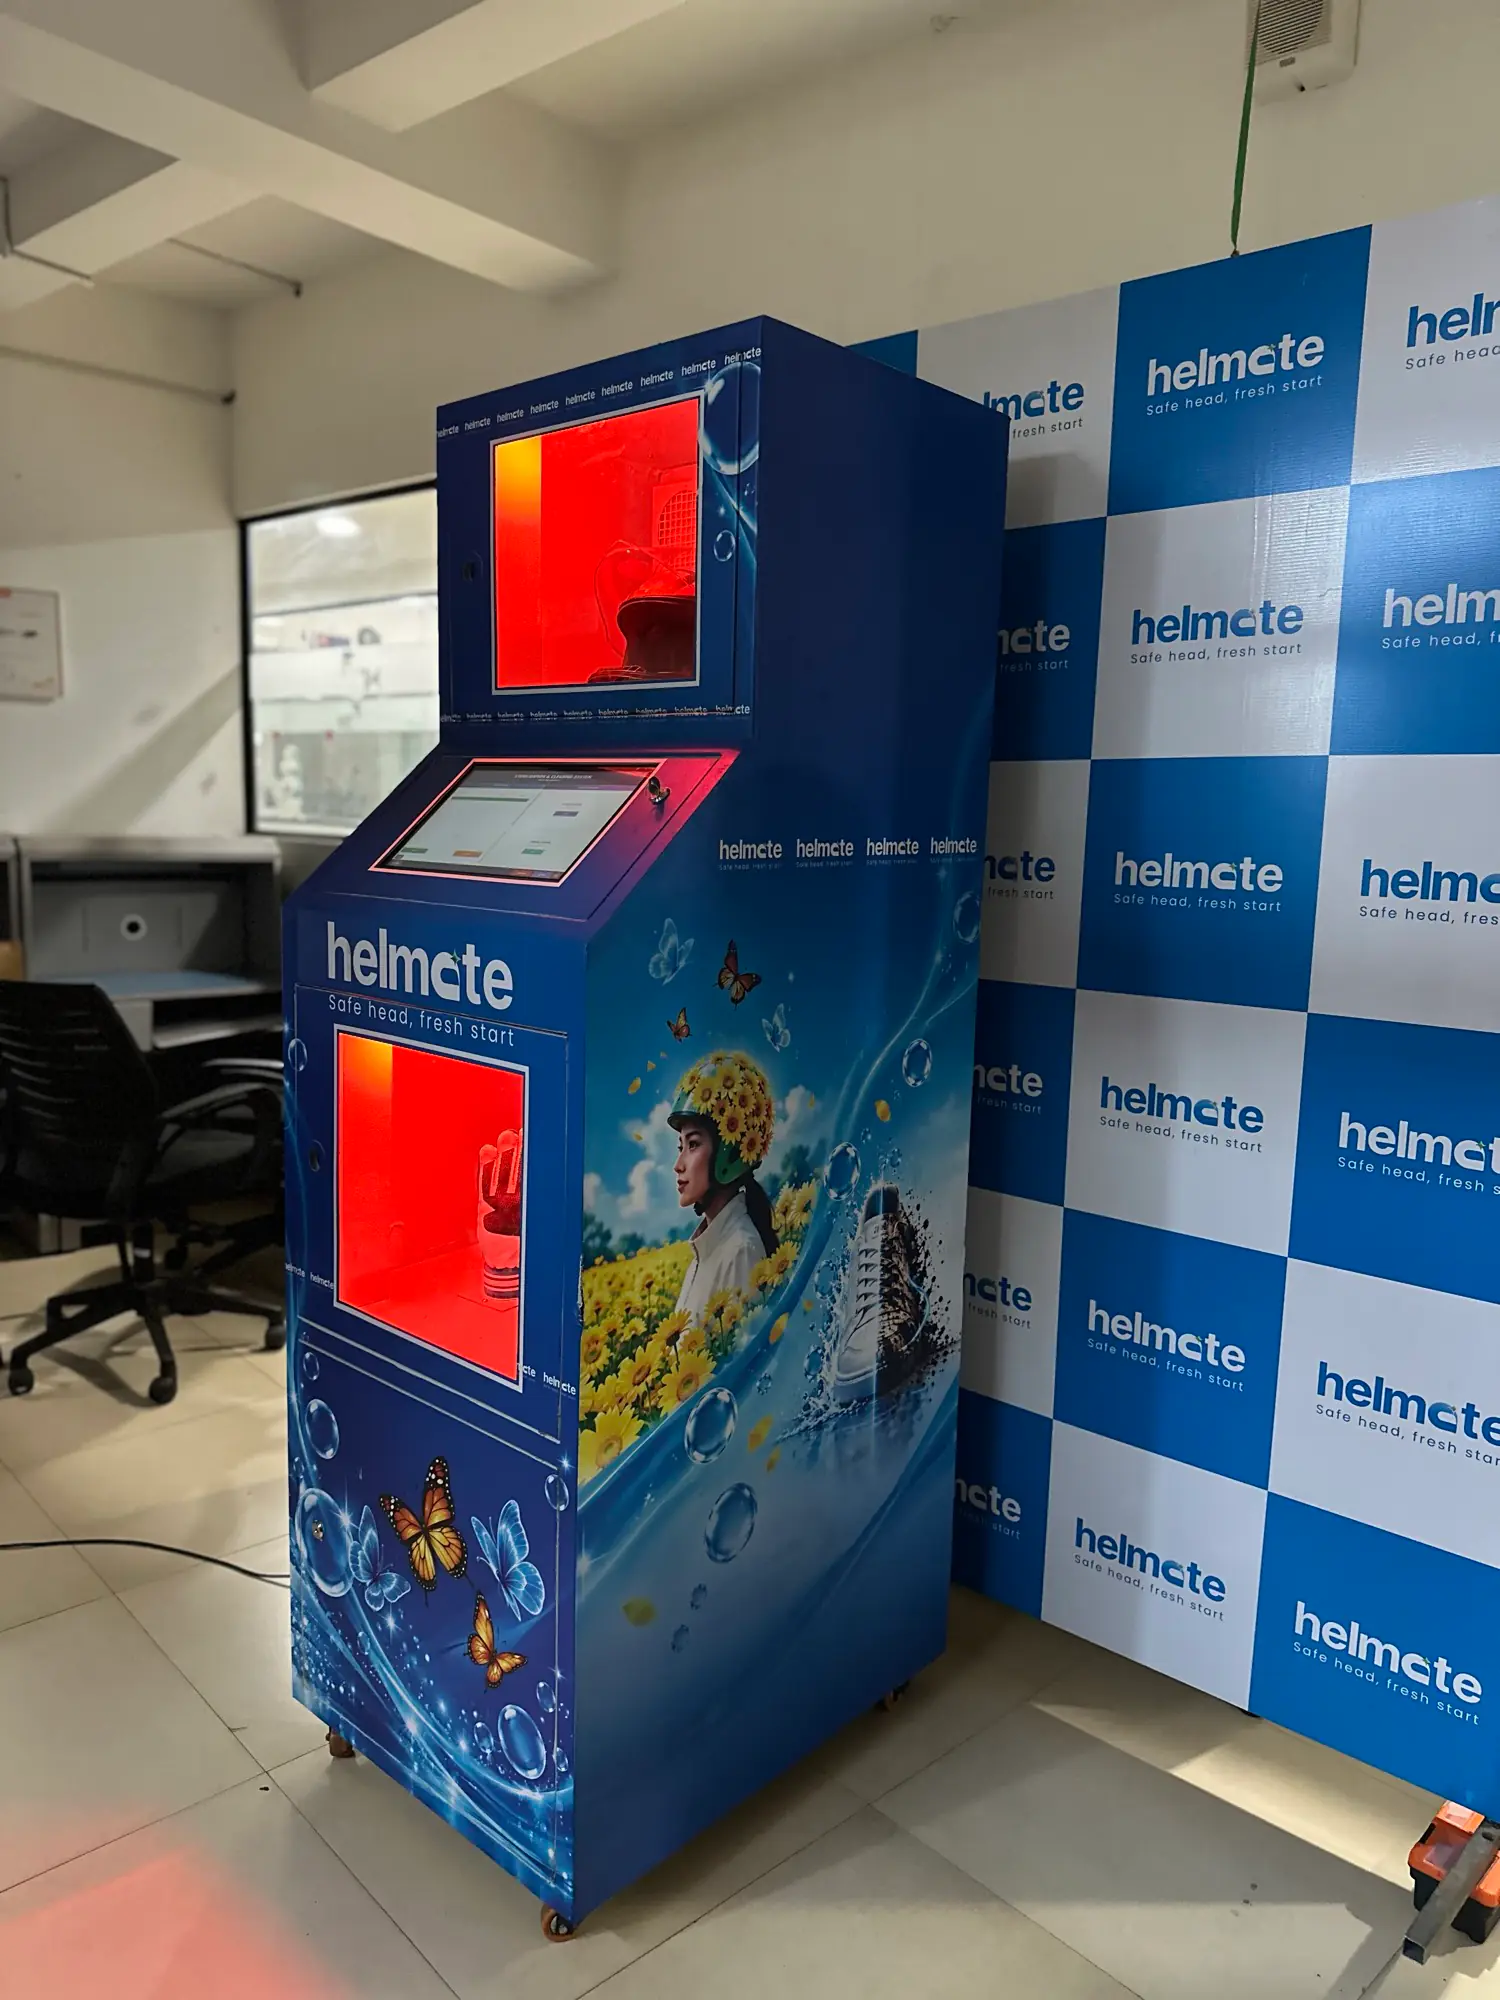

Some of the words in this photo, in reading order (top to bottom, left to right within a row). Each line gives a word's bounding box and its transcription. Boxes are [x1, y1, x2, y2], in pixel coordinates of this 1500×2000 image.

[601, 380, 634, 396] helmate
[640, 370, 674, 387] helmate
[681, 358, 717, 376] helmate
[1147, 333, 1325, 396] helmate
[1406, 354, 1445, 370] Safe
[1146, 401, 1178, 416] Safe
[1185, 390, 1229, 409] head,
[1235, 382, 1275, 400] fresh
[1282, 375, 1323, 392] start
[1012, 422, 1045, 439] fresh
[1050, 418, 1084, 434] start
[1132, 600, 1304, 645] helmate
[1382, 635, 1421, 649] Safe
[1429, 632, 1481, 648] head,
[1037, 658, 1069, 672] start
[1130, 651, 1162, 664] Safe
[1169, 648, 1211, 662] head,
[1217, 646, 1256, 659] fresh
[1263, 643, 1302, 656] start
[719, 839, 782, 860] helmate
[796, 838, 854, 858] helmate
[866, 837, 920, 856] helmate
[930, 836, 978, 855] helmate
[1114, 851, 1284, 893] helmate
[988, 886, 1019, 899] fresh
[1023, 888, 1054, 900] start
[1114, 893, 1145, 906] Safe
[1150, 894, 1192, 908] head,
[1198, 896, 1236, 910] fresh
[1243, 900, 1282, 912] start
[1360, 905, 1398, 919] Safe
[1405, 908, 1456, 924] head,
[1464, 912, 1500, 926] fres
[327, 921, 513, 1010] helmate
[328, 995, 362, 1016] Safe
[368, 1002, 413, 1028] head,
[420, 1011, 463, 1036] fresh
[470, 1024, 514, 1046] start
[1012, 1102, 1042, 1116] start
[1100, 1076, 1264, 1133] helmate
[1099, 1116, 1130, 1130] Safe
[1135, 1122, 1176, 1140] head,
[1181, 1130, 1219, 1146] fresh
[1225, 1138, 1262, 1153] start
[1338, 1156, 1374, 1173] Safe
[1382, 1164, 1430, 1184] head,
[1438, 1173, 1484, 1192] fresh
[1002, 1314, 1032, 1330] start
[1088, 1299, 1246, 1372] helmate
[1087, 1338, 1117, 1356] Safe
[1122, 1346, 1160, 1369] head,
[1166, 1360, 1202, 1380] fresh
[1208, 1373, 1244, 1391] start
[1316, 1404, 1352, 1422] Safe
[1358, 1415, 1405, 1440] head,
[1412, 1432, 1457, 1454] fresh
[1465, 1448, 1500, 1466] star
[1074, 1517, 1226, 1603] helmate
[1074, 1554, 1102, 1574] Safe
[1107, 1566, 1145, 1590] head,
[1150, 1584, 1184, 1606] fresh
[1190, 1600, 1225, 1622] start
[1294, 1600, 1482, 1704] helmate
[1293, 1641, 1328, 1664] Safe
[1334, 1657, 1380, 1686] head,
[1387, 1678, 1430, 1705] fresh
[1436, 1700, 1480, 1726] start
